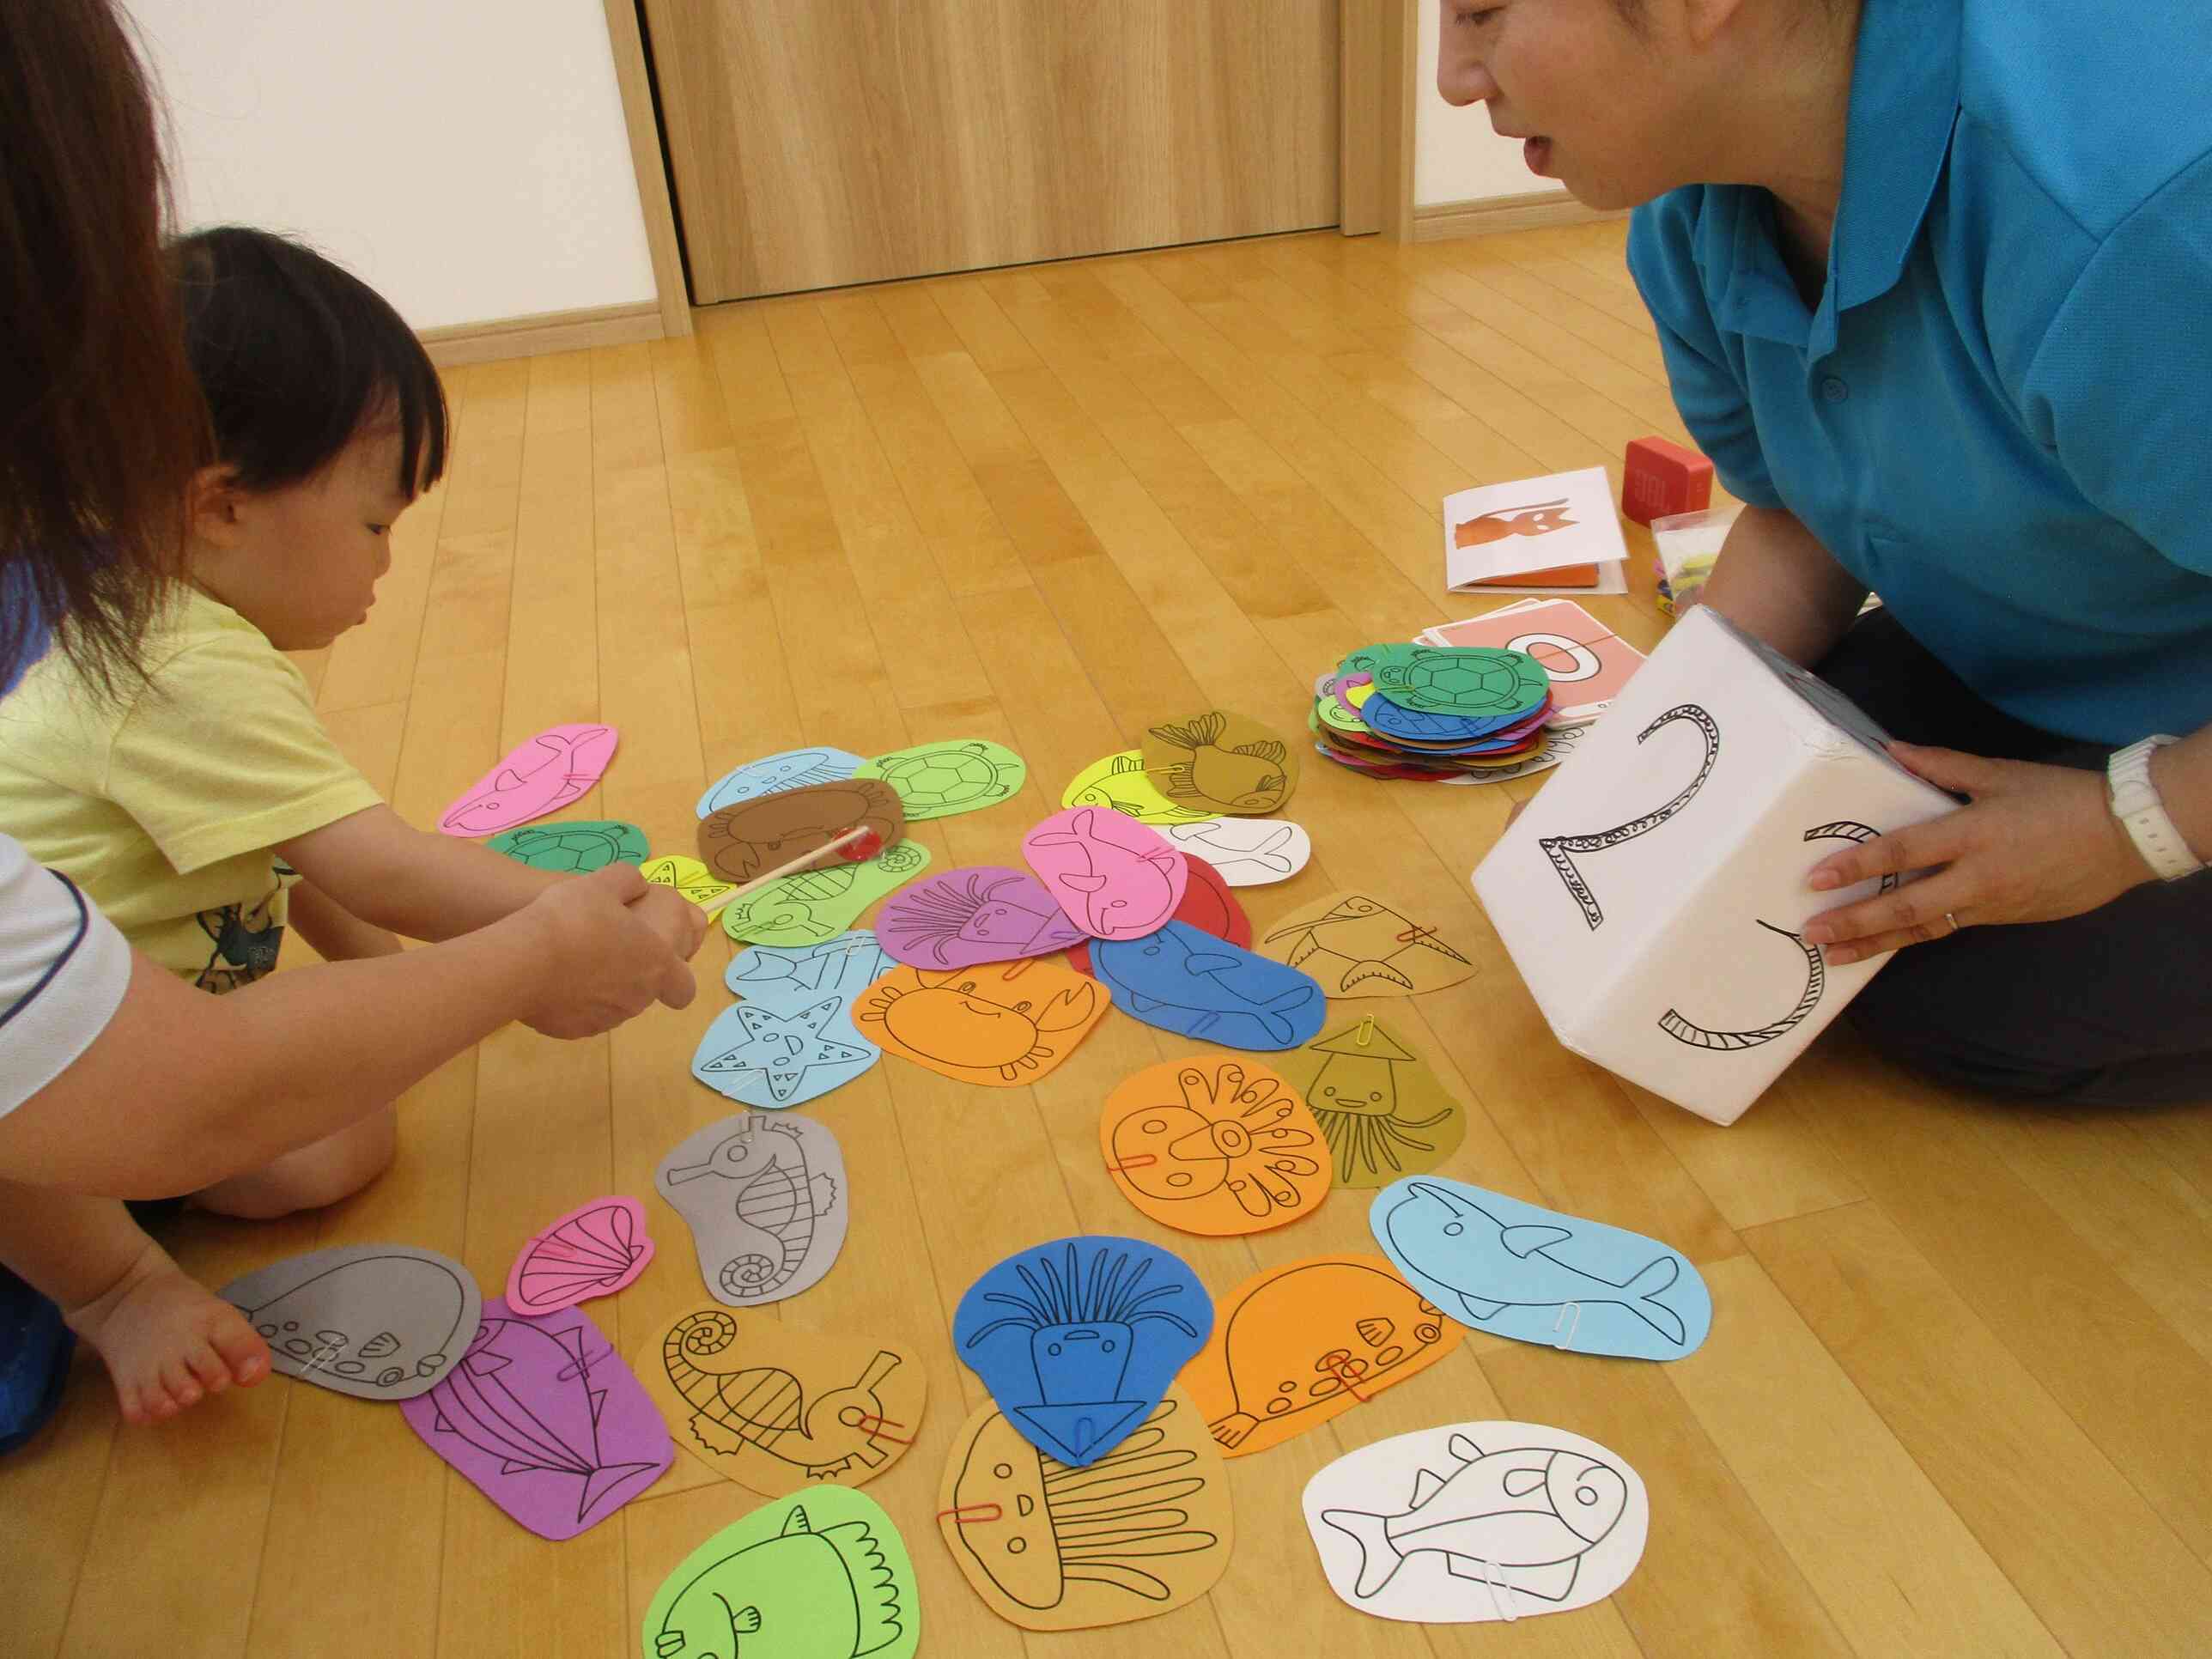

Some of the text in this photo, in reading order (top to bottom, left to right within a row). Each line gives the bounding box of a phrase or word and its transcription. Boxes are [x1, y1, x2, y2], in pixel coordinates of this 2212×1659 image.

[1634, 469, 1670, 511] JBL
[1539, 704, 1719, 931] 2
[1658, 821, 1898, 1051] 3
